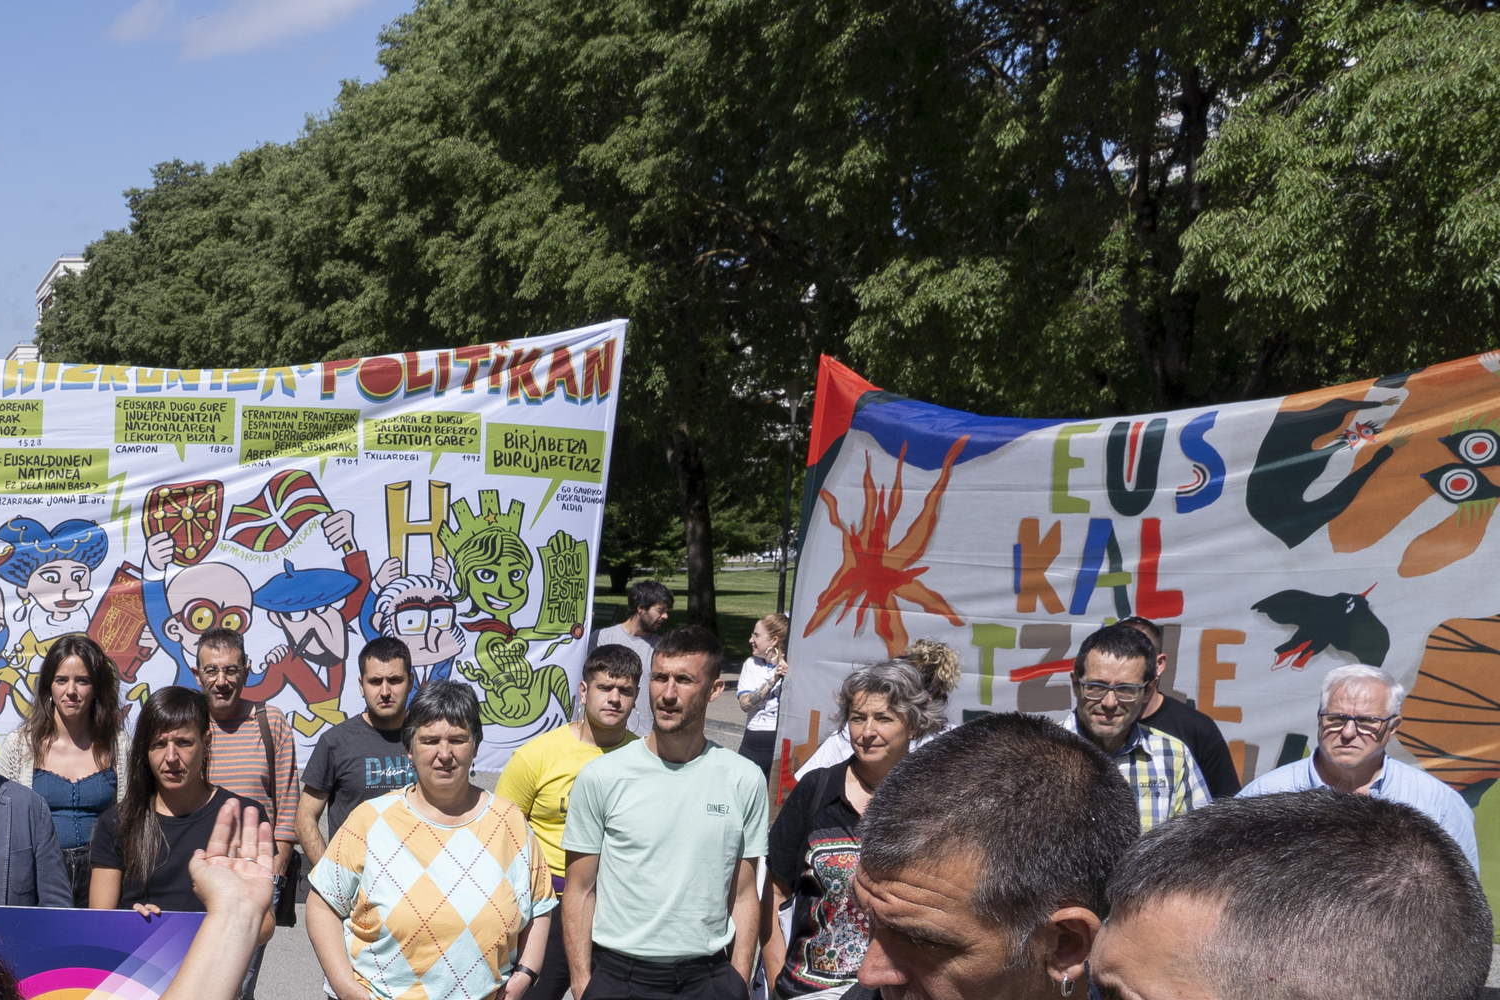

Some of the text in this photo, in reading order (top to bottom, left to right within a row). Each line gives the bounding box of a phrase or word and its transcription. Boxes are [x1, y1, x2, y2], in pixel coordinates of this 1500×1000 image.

[320, 338, 618, 405] POLITIKAN
[170, 401, 196, 411] DUGU
[199, 402, 228, 412] GURE
[125, 410, 221, 423] INDEPENDENTZIA
[421, 415, 432, 424] EZ
[436, 415, 463, 425] DUGU
[124, 421, 215, 433] NAZIONALAREN
[248, 421, 356, 432] ESPAINIAN ESPAINIERAK
[124, 432, 182, 442] LEKUKOTZA
[243, 430, 271, 441] BEZAIN
[377, 433, 432, 446] ESTATUA
[115, 445, 158, 454] CAMPION
[208, 445, 233, 454] 1880
[364, 451, 419, 461] TXILLARDEGI
[461, 454, 481, 463] 1992
[335, 458, 359, 466] 1901
[1050, 409, 1227, 517] EUS
[17, 467, 80, 480] NATIONEA
[5, 481, 17, 490] EZ
[20, 481, 43, 490] DELA
[45, 481, 66, 490] HAIN
[573, 486, 602, 496] GAURKO
[47, 495, 76, 506] JOANA
[556, 493, 605, 504] EUSKALDUNON
[561, 503, 583, 512] ALDIA
[547, 552, 583, 579] FORU
[1013, 517, 1185, 619] KAL
